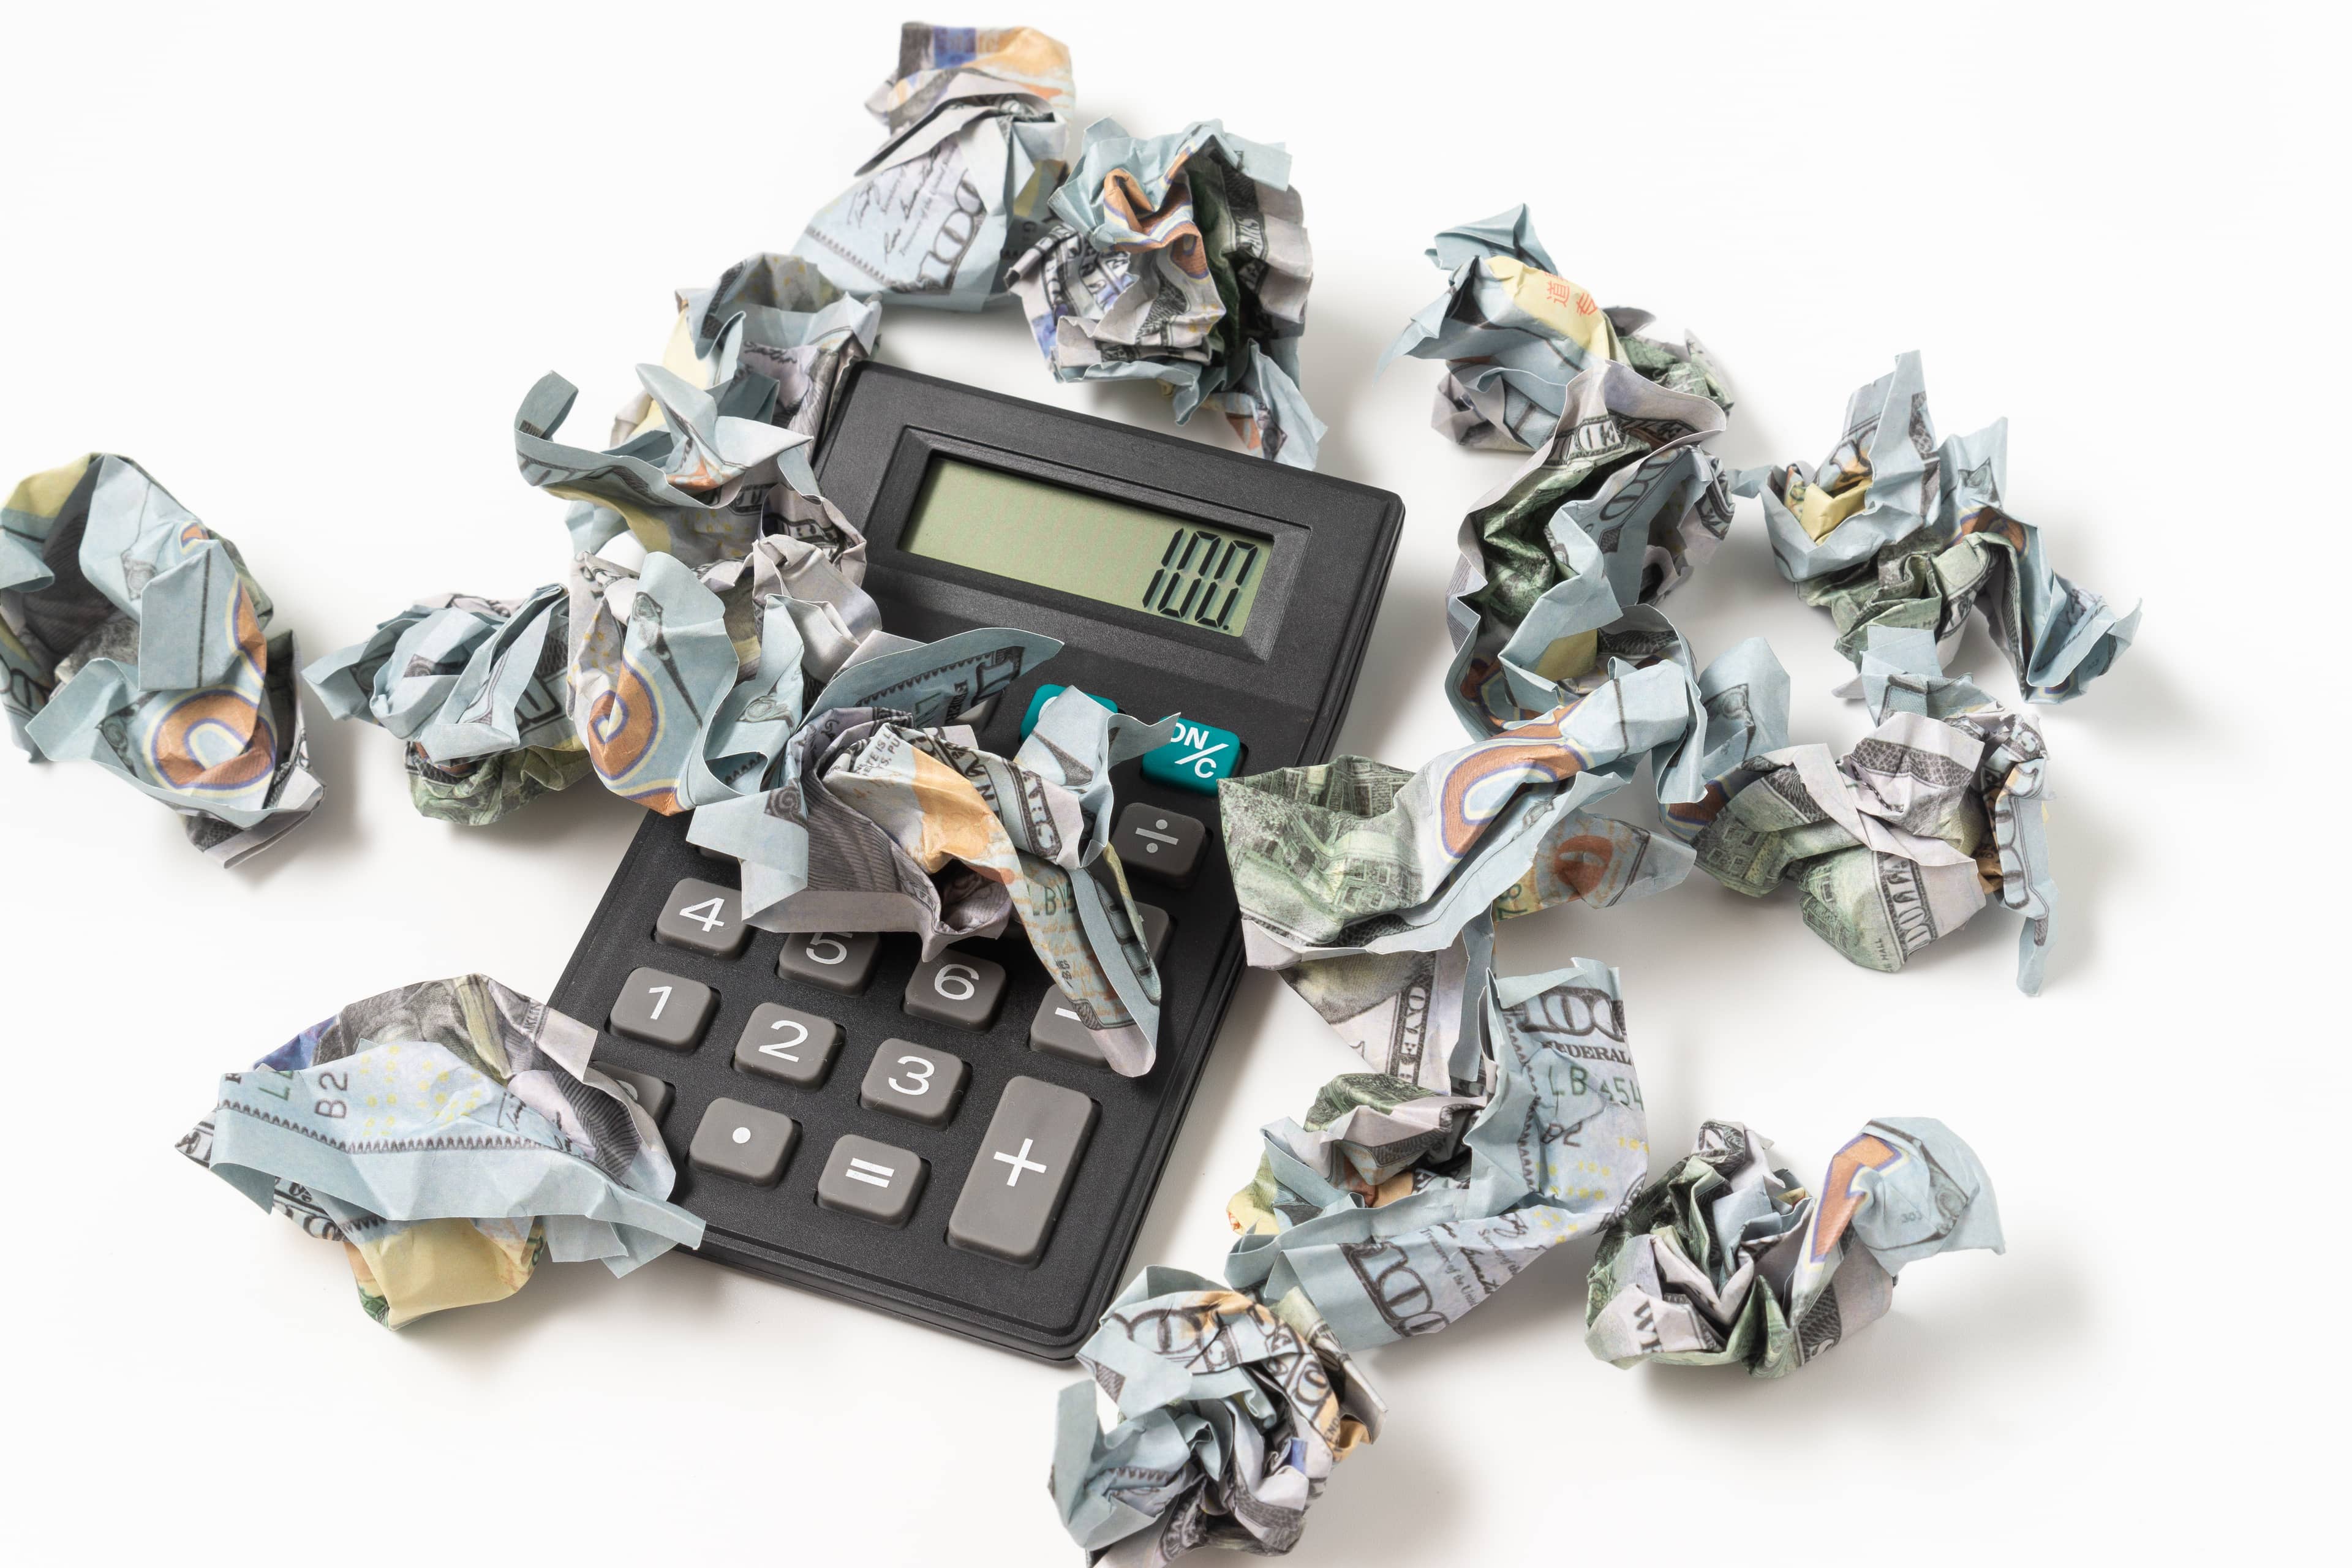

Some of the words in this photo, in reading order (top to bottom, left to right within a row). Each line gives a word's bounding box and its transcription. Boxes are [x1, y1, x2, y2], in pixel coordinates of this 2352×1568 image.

[679, 898, 725, 932] 4
[805, 932, 847, 965] 5
[934, 963, 979, 1001] 6
[649, 986, 673, 1020] 1
[759, 1020, 806, 1062] 2
[888, 1055, 935, 1096] 3
[314, 1071, 349, 1120] B2
